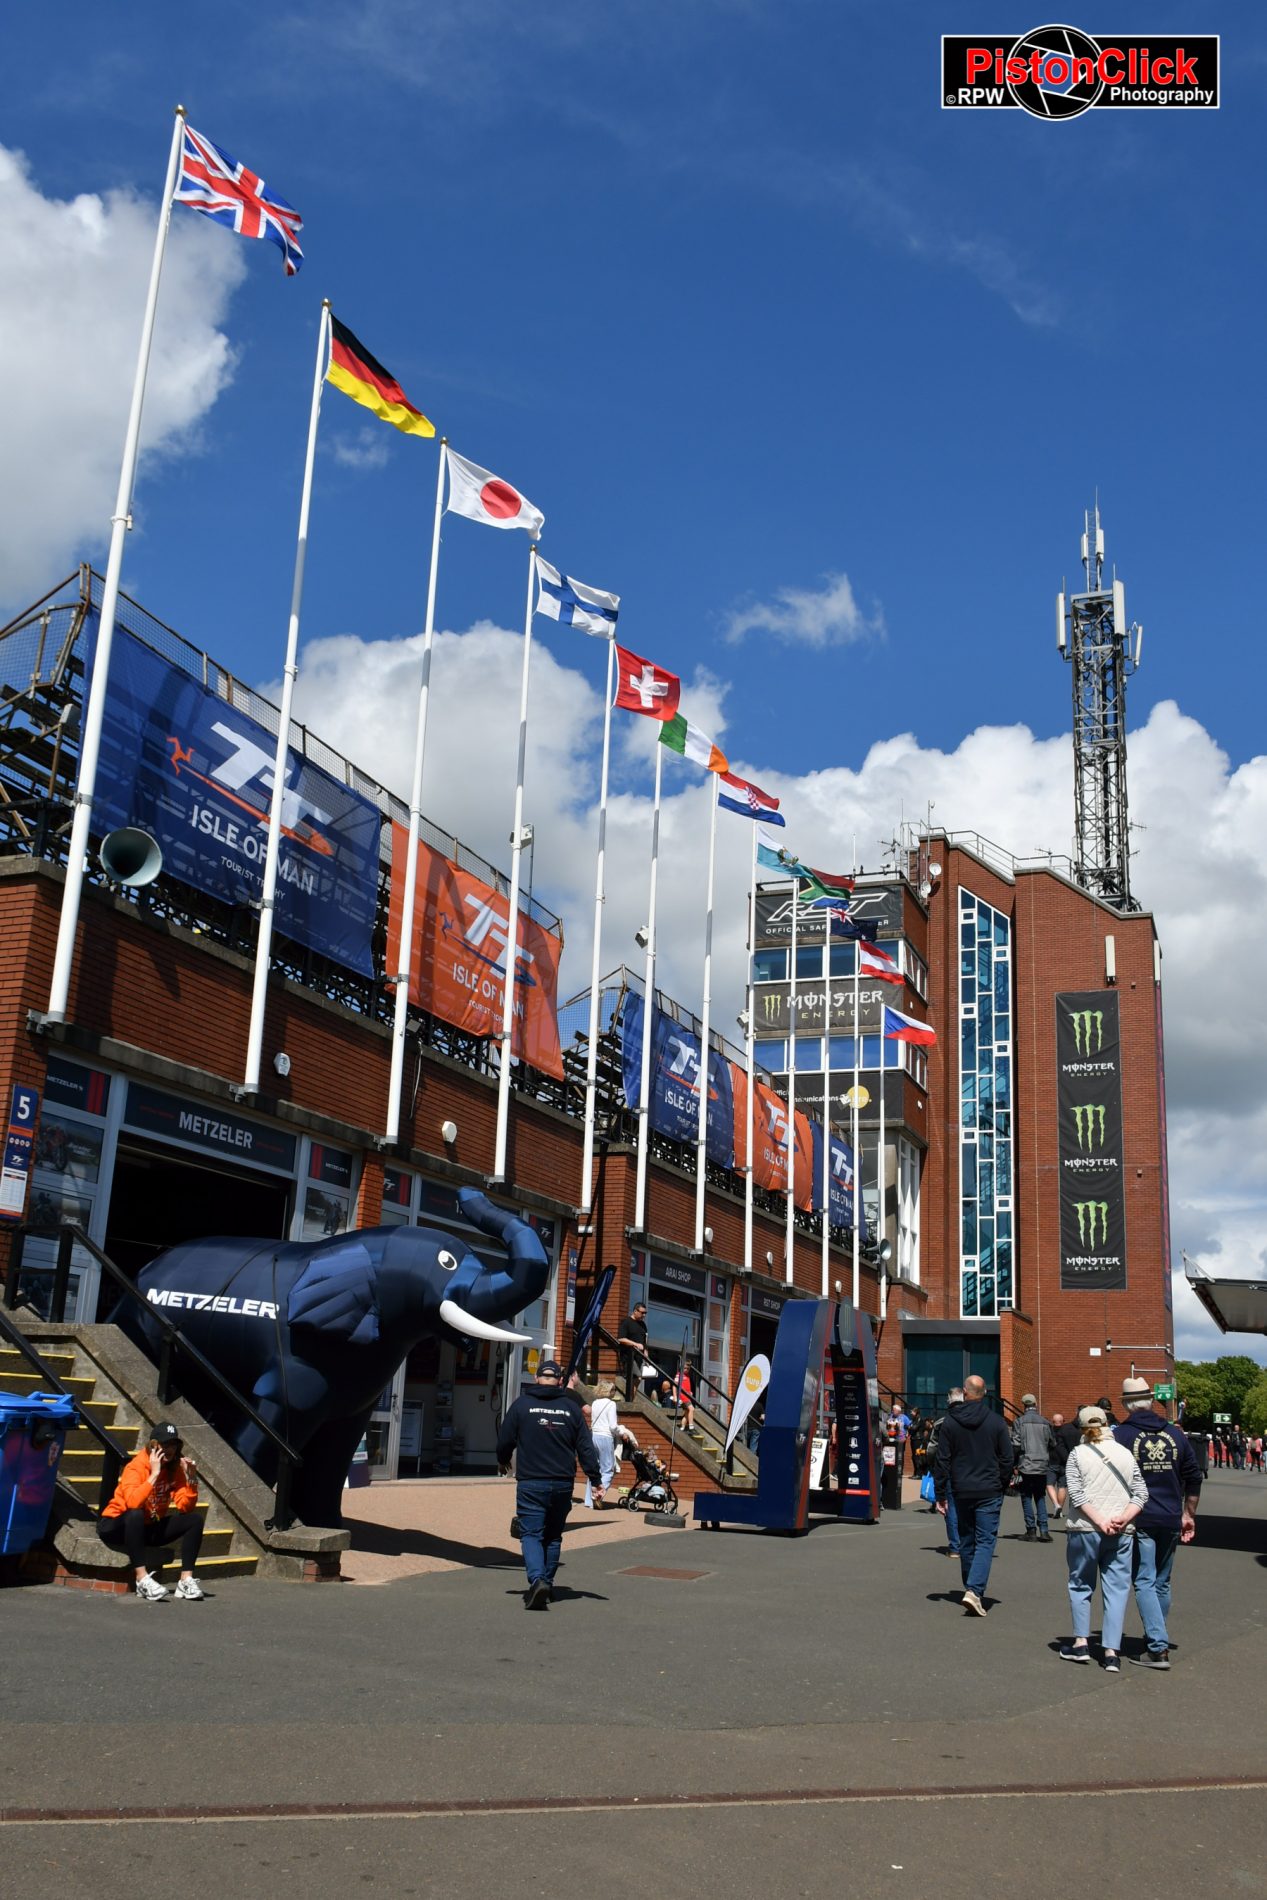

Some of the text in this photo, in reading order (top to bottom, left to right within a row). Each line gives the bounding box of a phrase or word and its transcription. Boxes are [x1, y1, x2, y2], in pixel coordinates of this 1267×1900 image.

[191, 805, 239, 849] ISLE
[221, 856, 253, 881] TOURIST
[464, 892, 535, 981] TT
[765, 925, 807, 935] OFFICAL
[452, 962, 479, 993] ISLE
[482, 980, 497, 1001] OF
[1062, 1062, 1115, 1073] MONSTER
[17, 1095, 31, 1120] 5
[665, 1089, 697, 1116] ISLE OF
[179, 1111, 253, 1149] METZELER
[831, 1146, 854, 1191] TT
[1064, 1157, 1118, 1168] MONSTER
[1066, 1256, 1120, 1266] MONSTER
[678, 1270, 692, 1283] SHOP
[146, 1288, 280, 1320] METZELER
